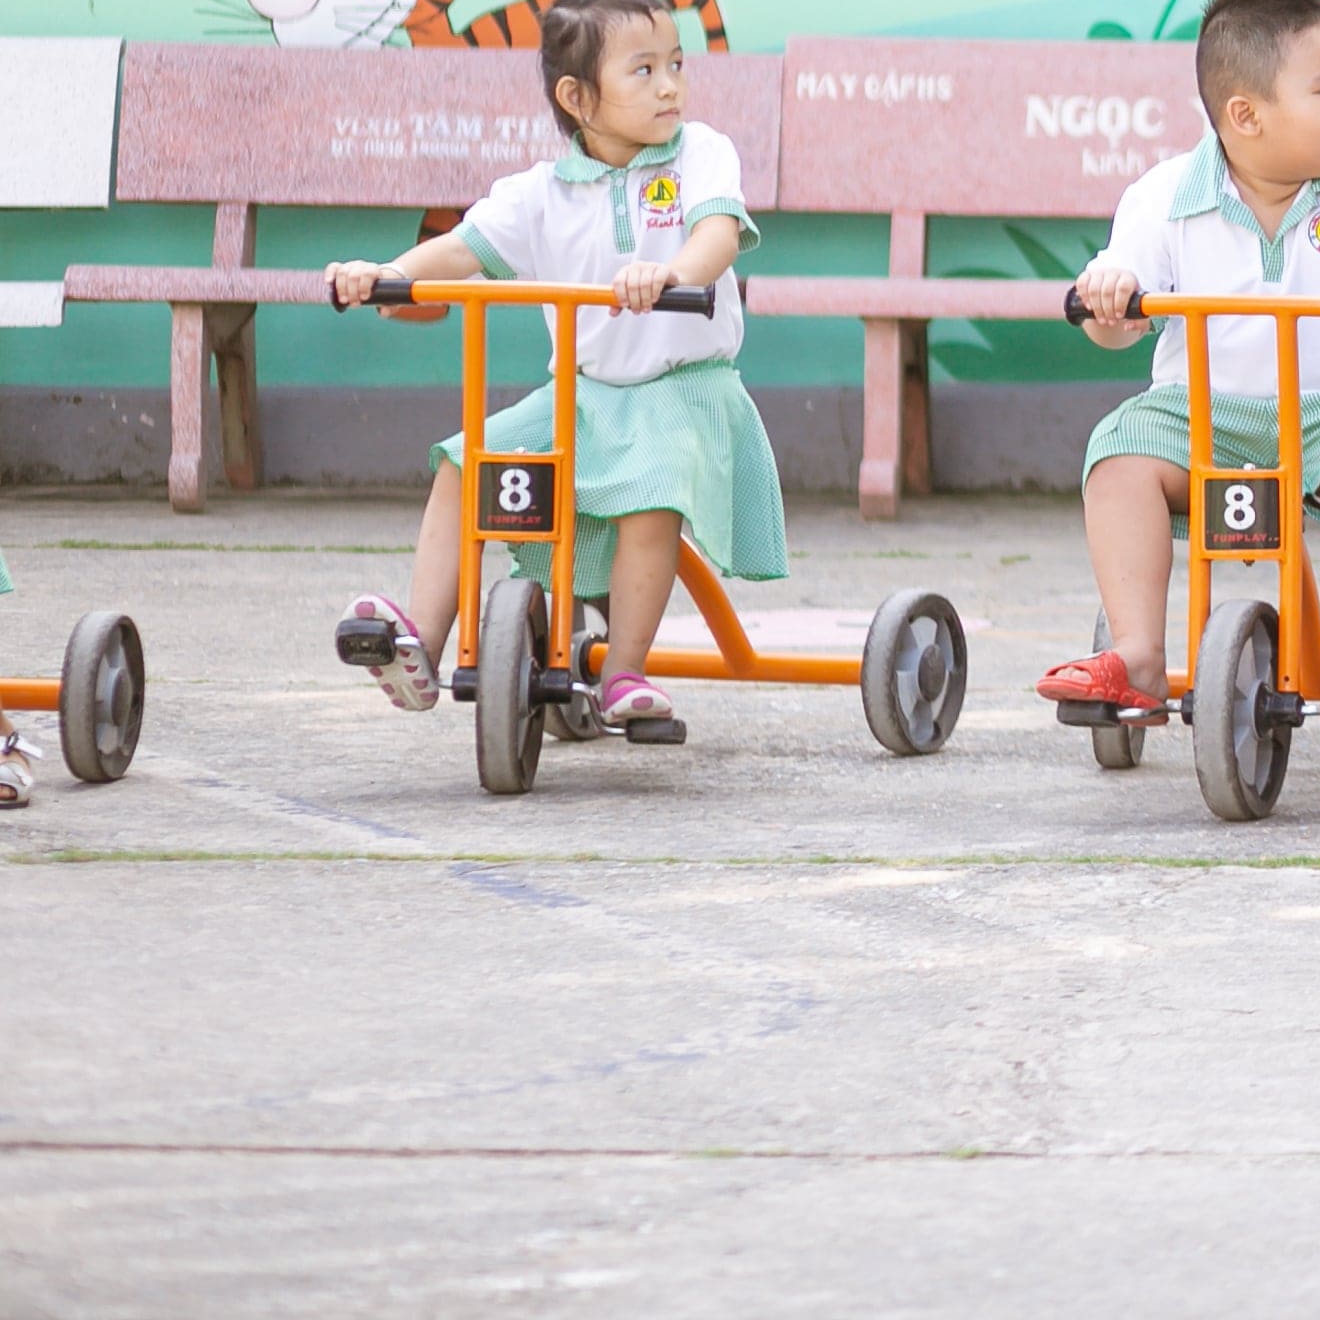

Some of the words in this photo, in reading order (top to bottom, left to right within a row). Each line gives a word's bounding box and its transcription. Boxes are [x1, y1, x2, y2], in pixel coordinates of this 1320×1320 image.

[796, 71, 858, 101] MAY
[1024, 94, 1167, 151] NGỌC
[499, 467, 531, 513] 8
[1223, 483, 1256, 531] 8
[1213, 532, 1268, 543] FUNPLAY
